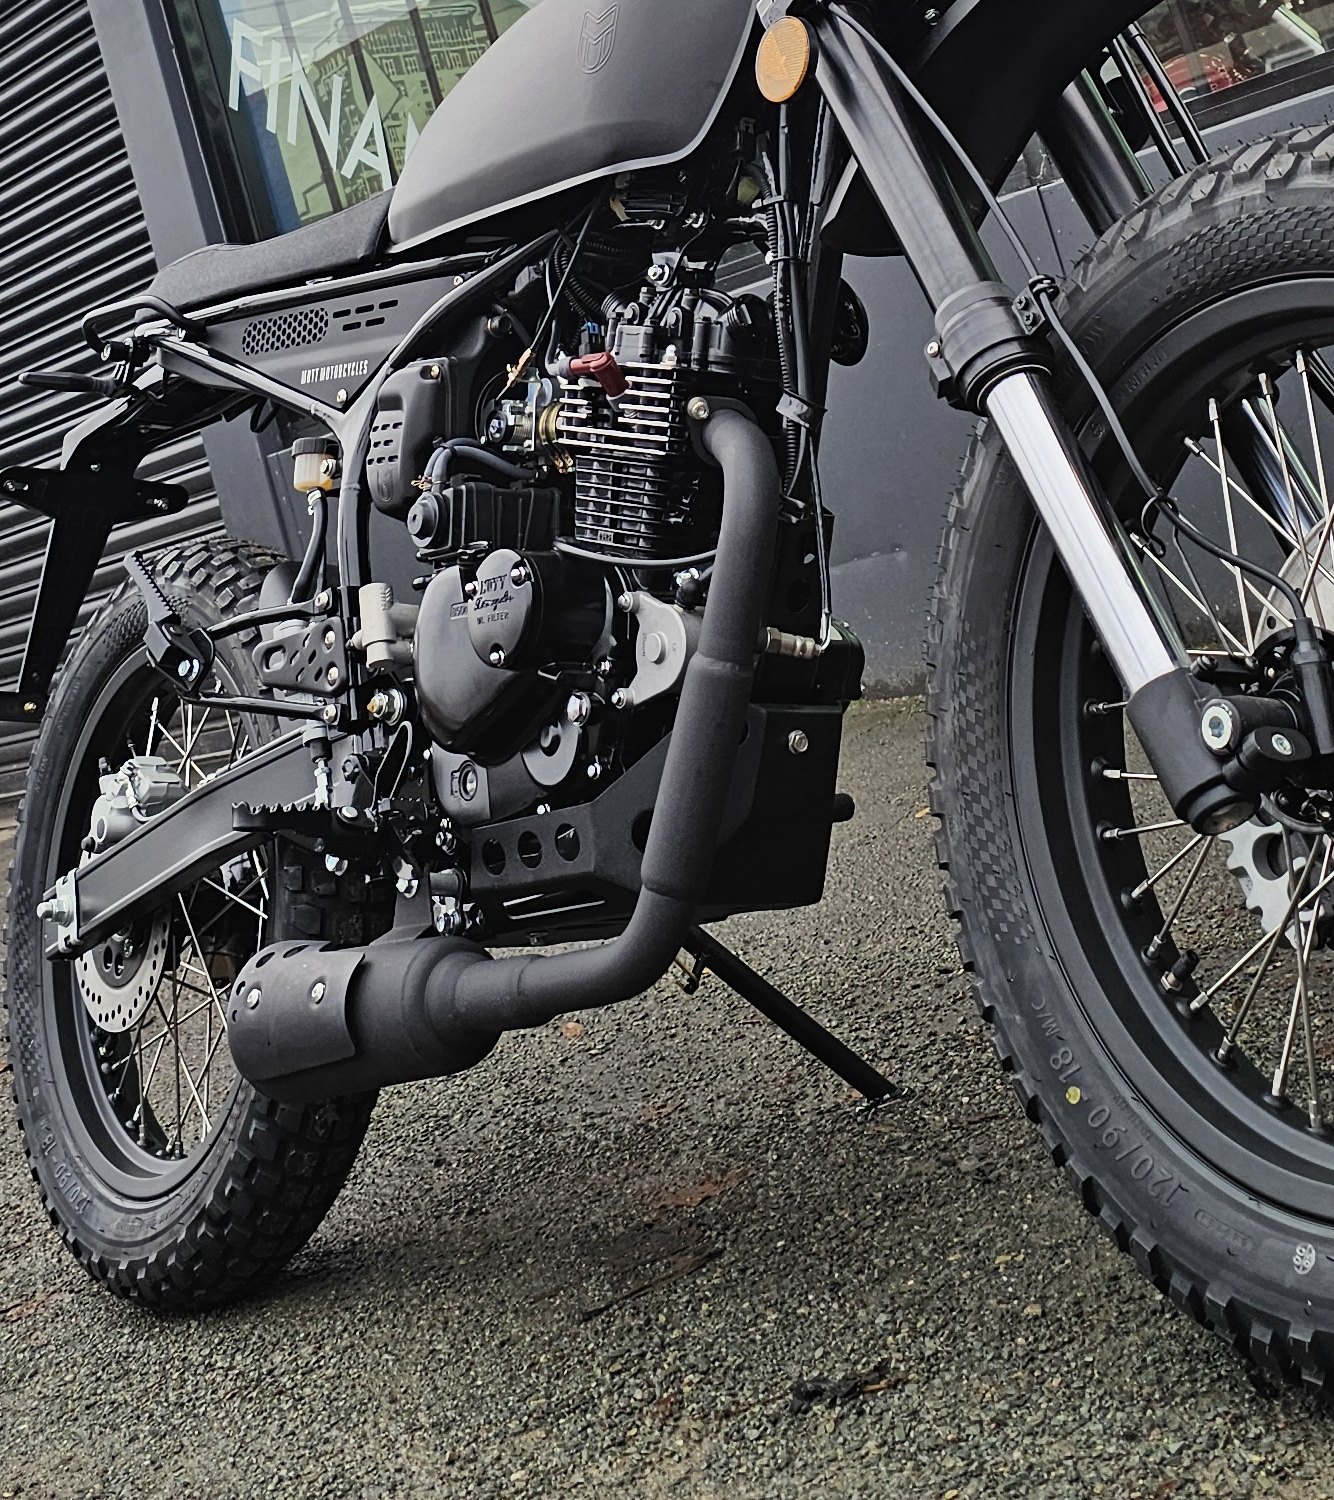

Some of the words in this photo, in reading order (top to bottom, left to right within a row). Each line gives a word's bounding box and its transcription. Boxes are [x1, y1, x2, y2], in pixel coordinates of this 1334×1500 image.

[319, 359, 368, 382] MOTORCYCLES
[1031, 998, 1060, 1037] M/C
[1050, 1047, 1081, 1083] 18
[1088, 1104, 1175, 1207] 120/90
